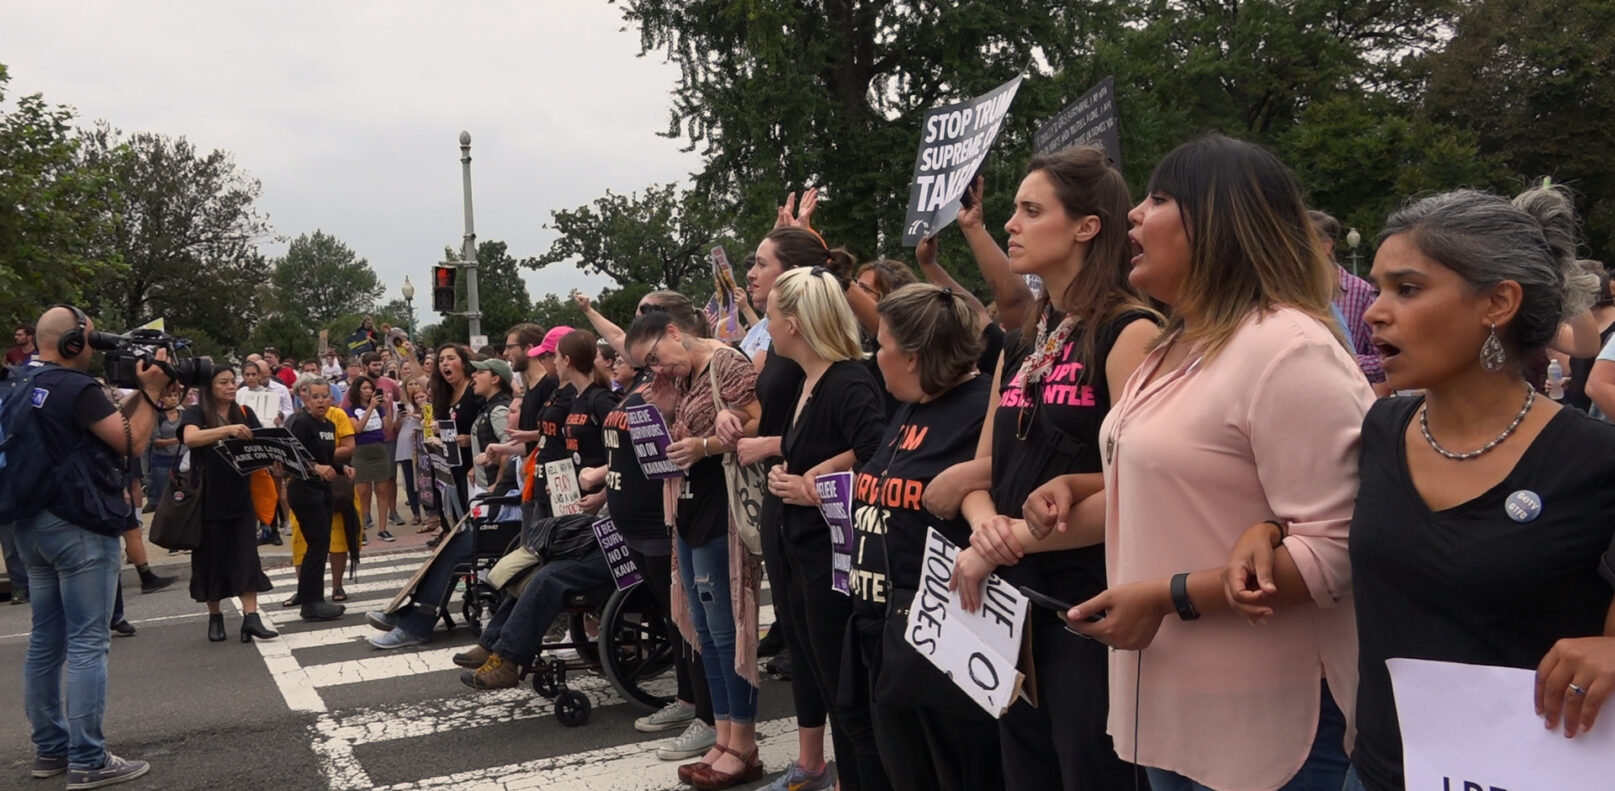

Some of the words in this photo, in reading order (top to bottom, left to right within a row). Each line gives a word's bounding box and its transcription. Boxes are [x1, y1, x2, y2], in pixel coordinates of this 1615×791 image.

[925, 108, 973, 143] STOP
[920, 132, 985, 171] SUPREME
[604, 429, 620, 448] AND
[234, 452, 254, 461] ARE
[254, 452, 268, 460] ON
[244, 445, 263, 454] OUR
[596, 526, 602, 537] I
[608, 549, 622, 563] NO
[857, 535, 866, 565] I
[613, 560, 638, 578] KAVA
[911, 531, 957, 656] HOUSES
